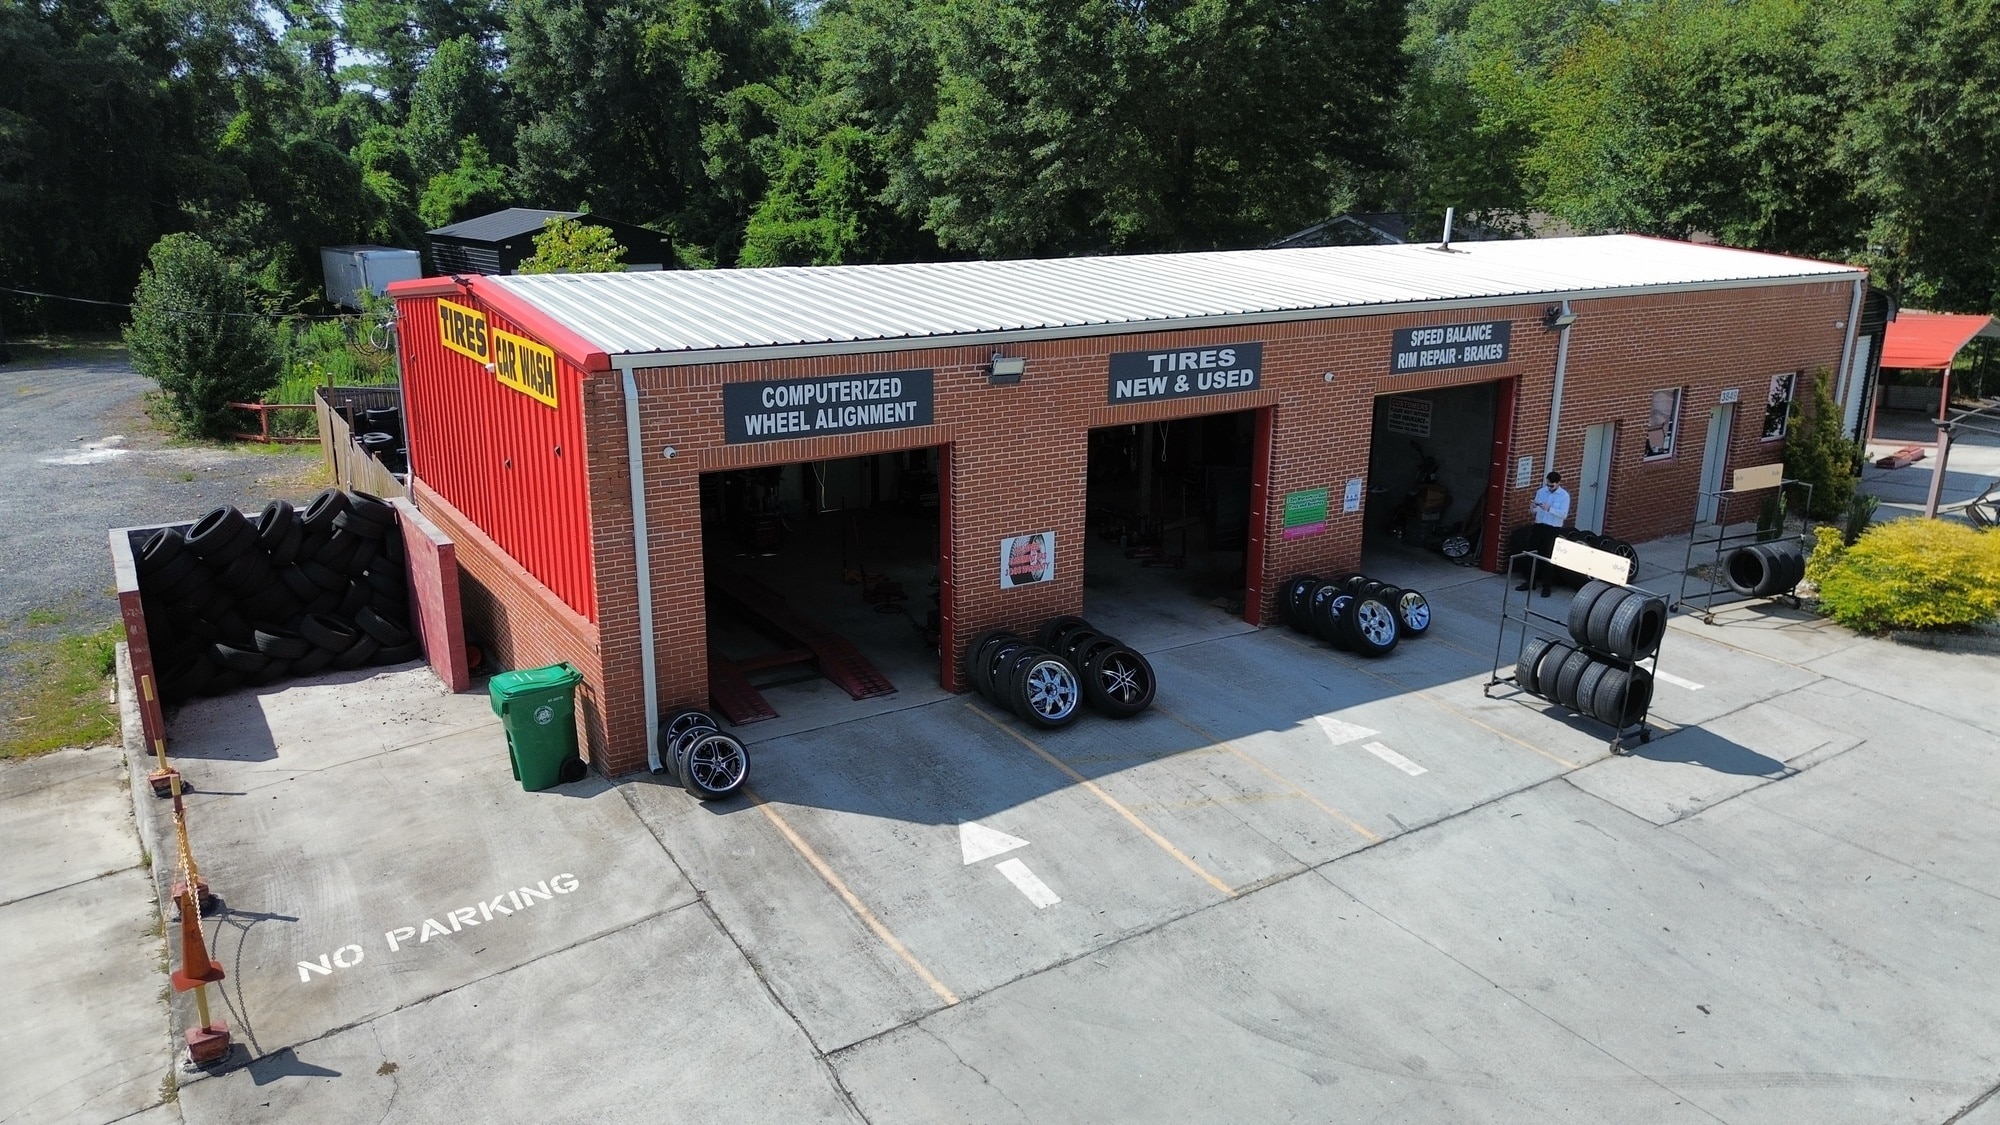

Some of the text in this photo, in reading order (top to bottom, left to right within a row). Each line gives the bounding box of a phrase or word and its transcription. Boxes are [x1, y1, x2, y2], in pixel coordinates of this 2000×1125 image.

[440, 305, 487, 357] TIRES
[1411, 324, 1493, 347] SPEED BALANCE
[496, 335, 555, 399] CAR WASH
[1148, 349, 1236, 373] TIRES
[1398, 350, 1417, 369] RIM
[1420, 348, 1456, 367] REPAIR
[1464, 344, 1503, 363] BRAKES
[762, 377, 902, 408] COMPUTERIZED
[1116, 369, 1254, 398] NEW & USED
[745, 401, 917, 436] WHEEL ALIGNMENT
[1391, 399, 1429, 411] CUSTOMERS
[296, 873, 579, 983] NO PARKING
